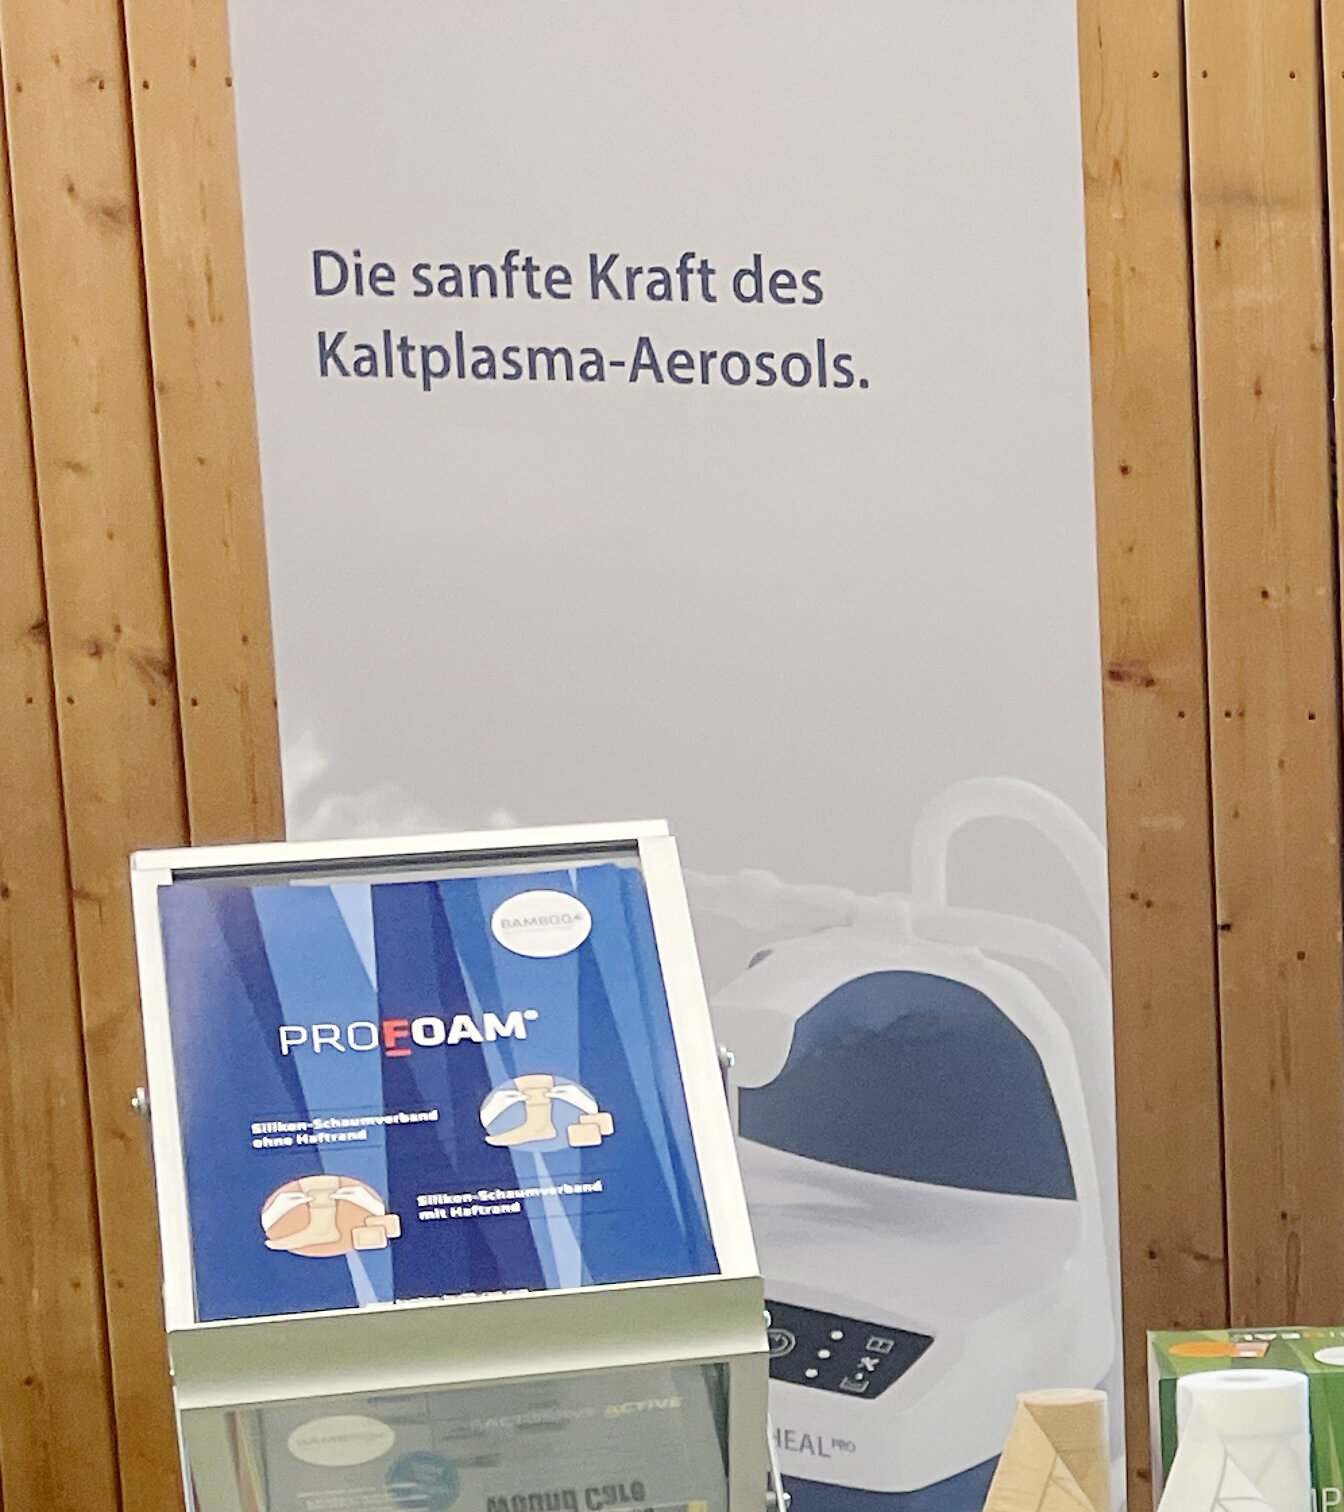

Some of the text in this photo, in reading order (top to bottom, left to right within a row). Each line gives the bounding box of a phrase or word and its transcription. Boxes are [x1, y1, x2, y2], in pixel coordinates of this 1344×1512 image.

[312, 249, 824, 306] Die sanfte Kraft des
[317, 329, 871, 393] Kaltplasma-Aerosols.
[251, 1109, 439, 1134] Silikon-Schaumverband
[252, 1129, 367, 1149] ohne Haftrand
[416, 1179, 603, 1206] Silikon-Schaumverband
[418, 1201, 521, 1220] mit Haftrand
